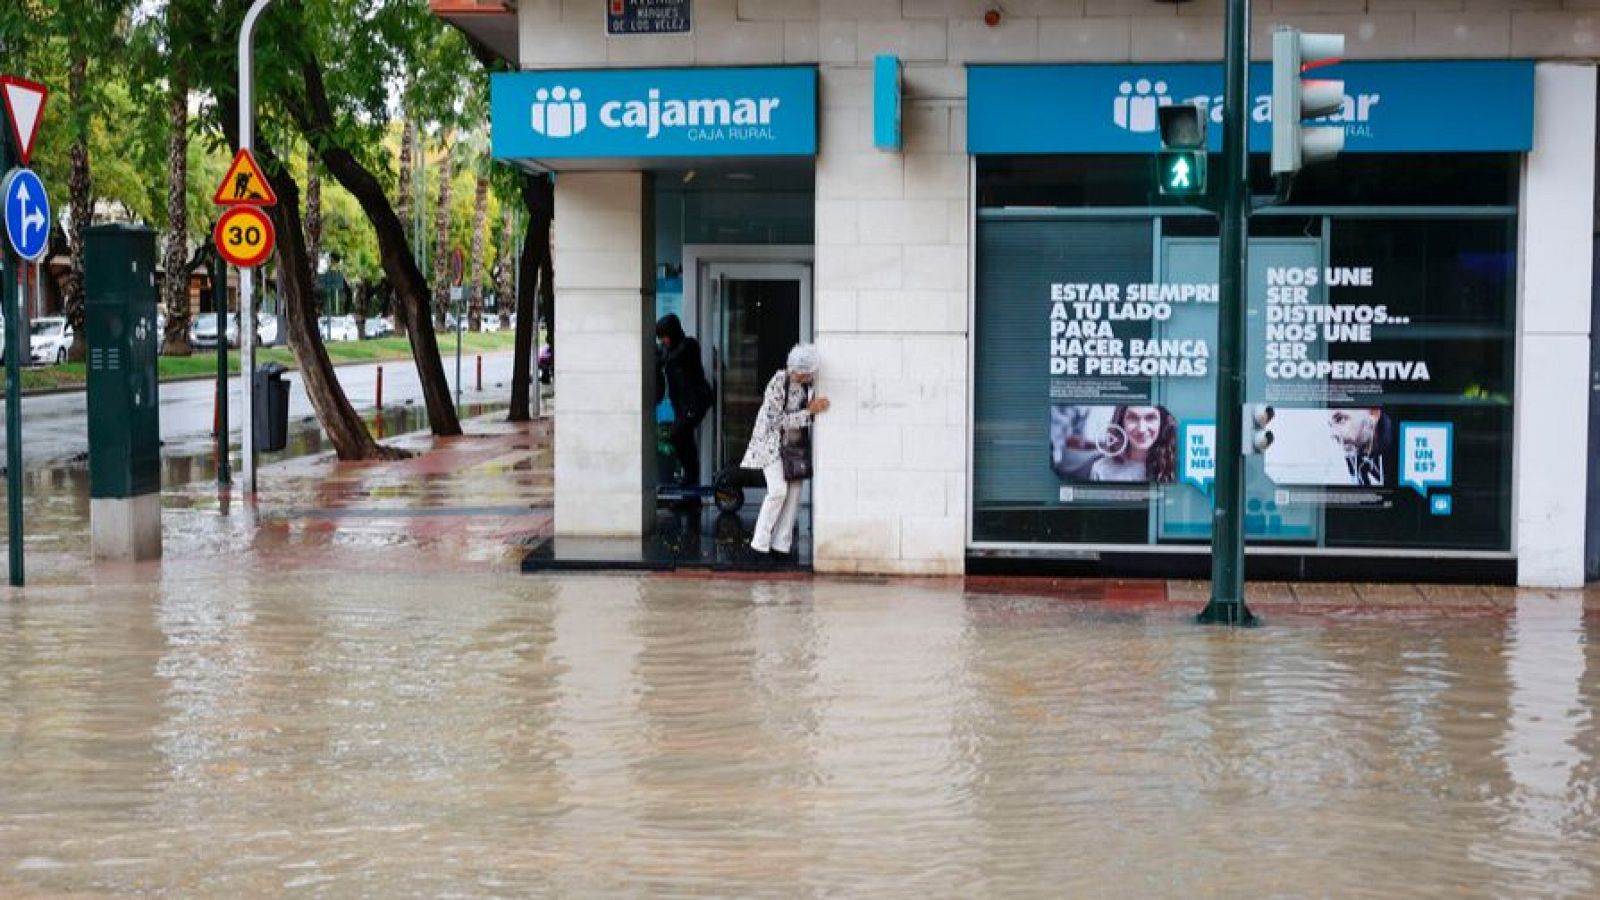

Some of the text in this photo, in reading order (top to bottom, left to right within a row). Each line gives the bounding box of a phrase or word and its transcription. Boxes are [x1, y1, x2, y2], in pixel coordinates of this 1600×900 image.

[612, 20, 625, 31] DE
[599, 88, 780, 138] cajamar
[687, 127, 776, 140] CAJA RURAL
[229, 226, 260, 246] 30
[1266, 267, 1373, 286] NOS UNE
[1050, 283, 1120, 301] ESTAR
[1266, 286, 1308, 303] SER
[1050, 302, 1171, 321] A TU LADO
[1266, 305, 1410, 324] DISTINTOS...
[1050, 320, 1114, 338] PARA
[1266, 323, 1372, 342] NOS UNE
[1050, 339, 1209, 357] HACER BANCA
[1265, 343, 1307, 361] SER
[1050, 357, 1208, 375] DE PERSONAS
[1265, 360, 1430, 380] COOPERATIVA
[1191, 434, 1204, 445] TE
[1415, 437, 1428, 447] TE
[1415, 449, 1433, 459] UN
[1415, 462, 1435, 472] ES?
